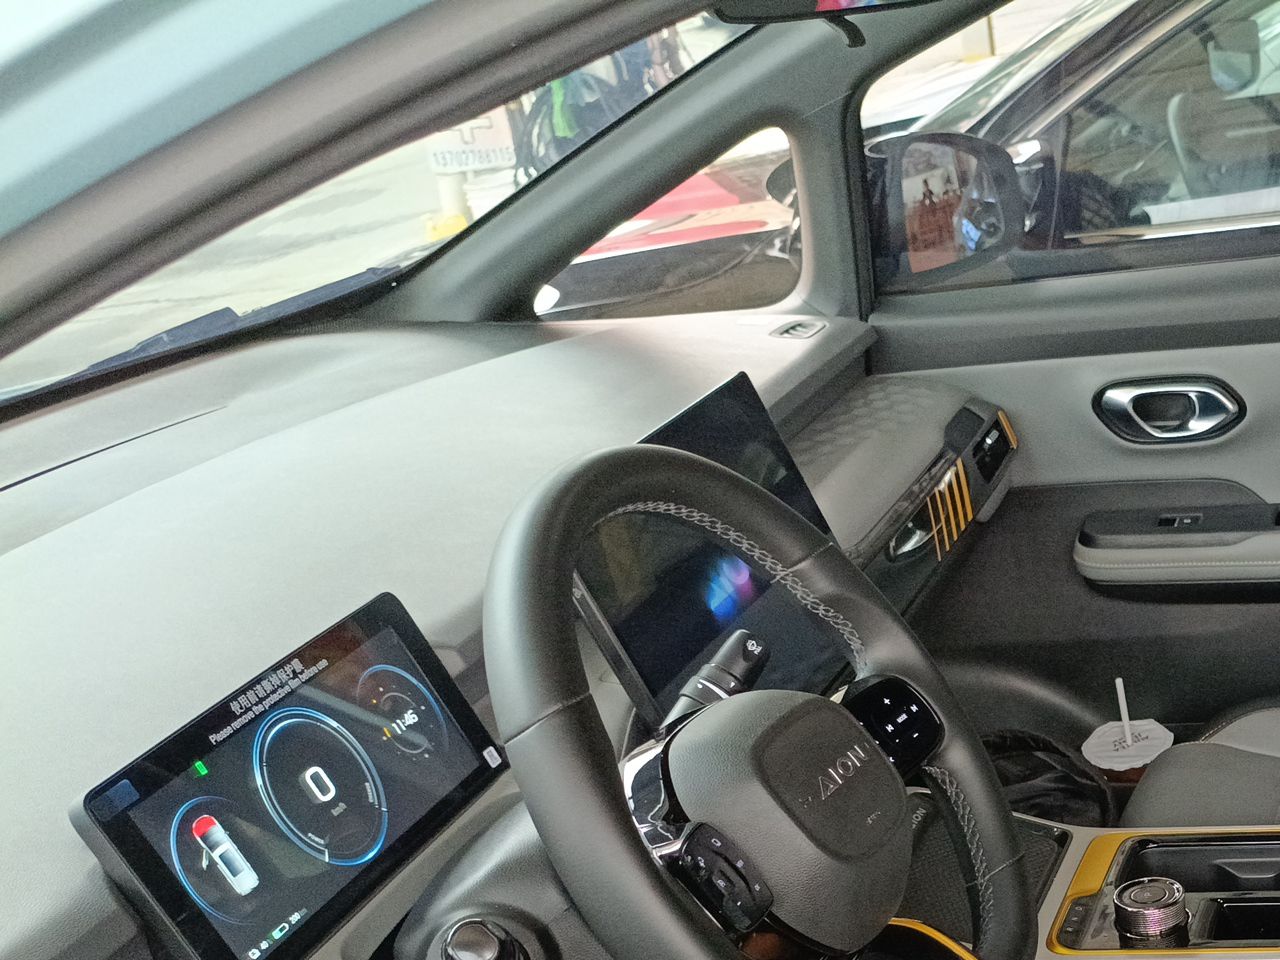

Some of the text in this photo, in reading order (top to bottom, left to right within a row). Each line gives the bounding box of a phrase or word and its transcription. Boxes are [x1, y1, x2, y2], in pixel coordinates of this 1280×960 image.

[208, 726, 233, 745] Please
[231, 711, 255, 731] remove
[254, 703, 265, 715] the
[263, 685, 291, 709] protective
[391, 709, 419, 735] 11:46
[305, 766, 336, 802] 0
[818, 745, 870, 801] AION
